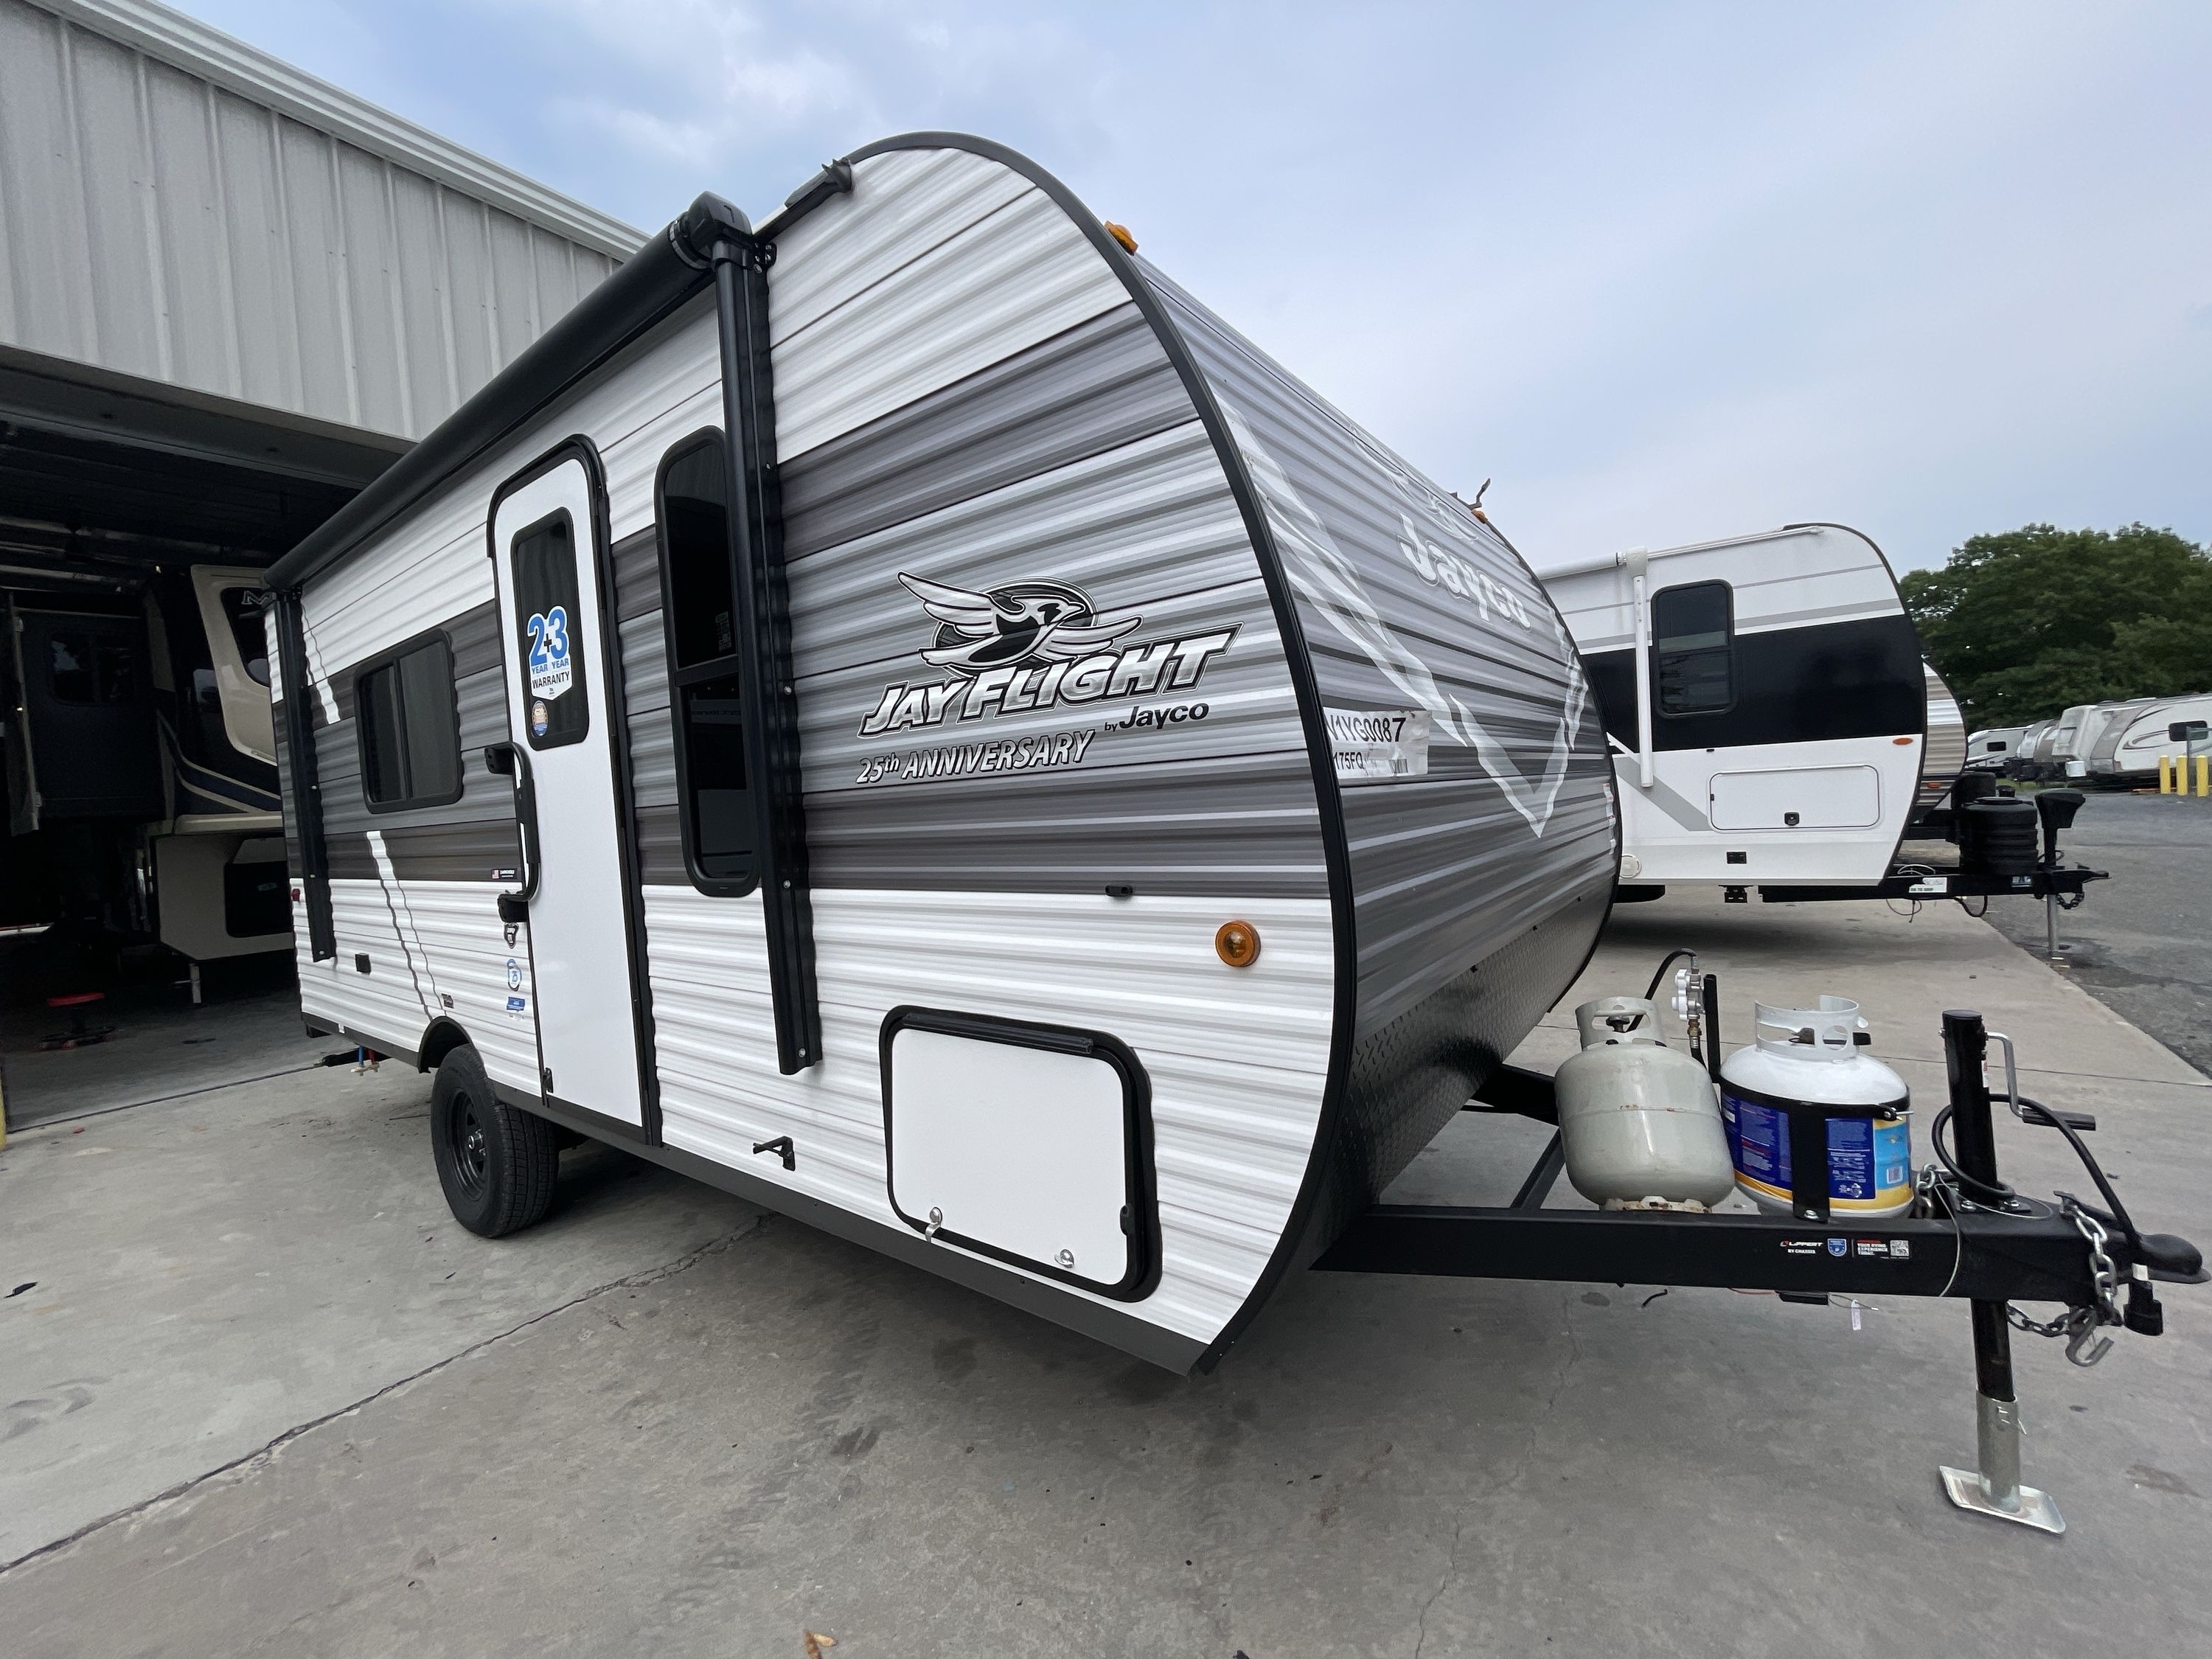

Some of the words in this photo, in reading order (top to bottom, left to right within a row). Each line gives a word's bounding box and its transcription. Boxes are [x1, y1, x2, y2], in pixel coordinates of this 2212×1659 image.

[1397, 512, 1532, 633] Jayco
[531, 664, 548, 675] YEAR
[552, 658, 569, 669] YEAR
[532, 670, 570, 689] WARRANTY
[861, 681, 966, 736] JAY
[961, 625, 1241, 719] FLIGHT
[1104, 721, 1119, 733] by
[1119, 701, 1210, 730] Jayco
[855, 757, 900, 784] 25th
[902, 728, 1096, 779] ANNIVERSARY
